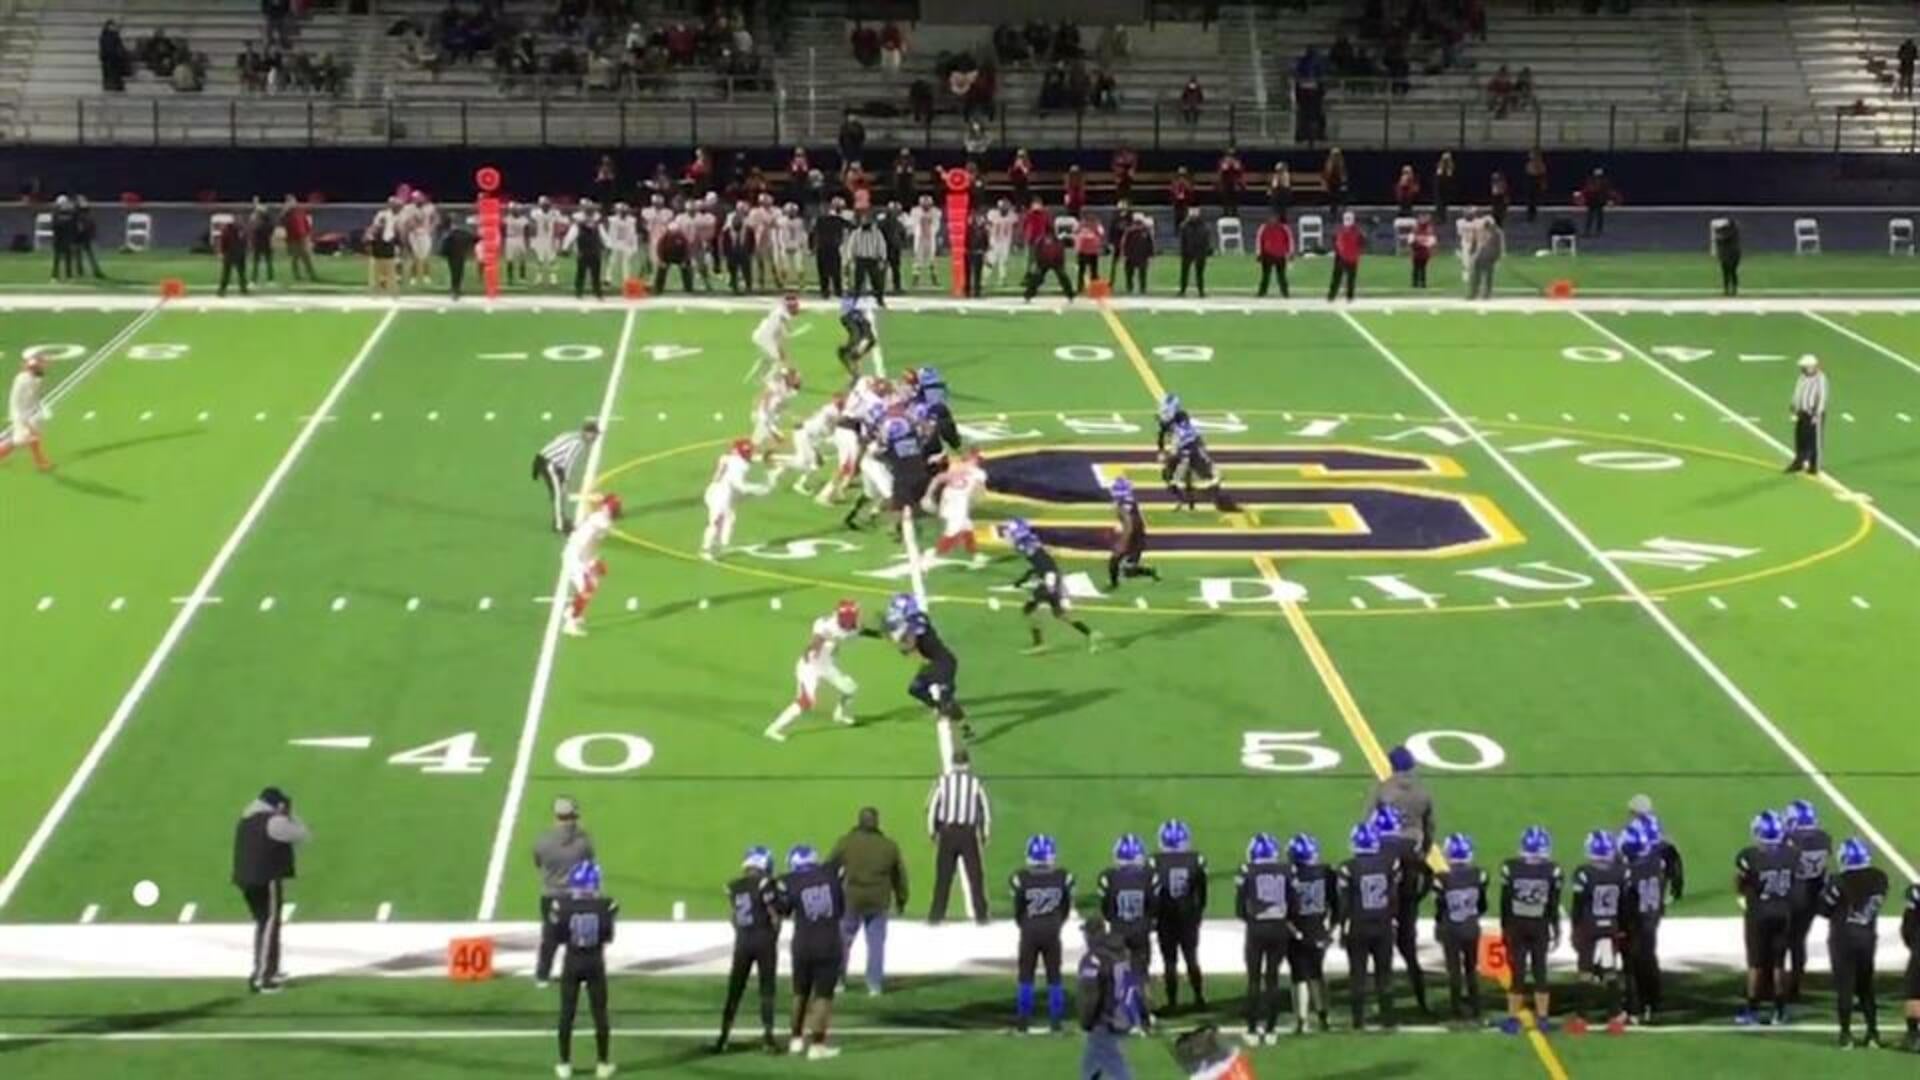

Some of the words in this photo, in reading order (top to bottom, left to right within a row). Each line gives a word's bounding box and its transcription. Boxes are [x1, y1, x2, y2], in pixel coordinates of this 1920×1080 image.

[738, 537, 1762, 604] STADIUM
[387, 732, 653, 774] 40
[1241, 730, 1505, 771] 50
[453, 946, 488, 974] 40
[1486, 943, 1506, 969] 5
